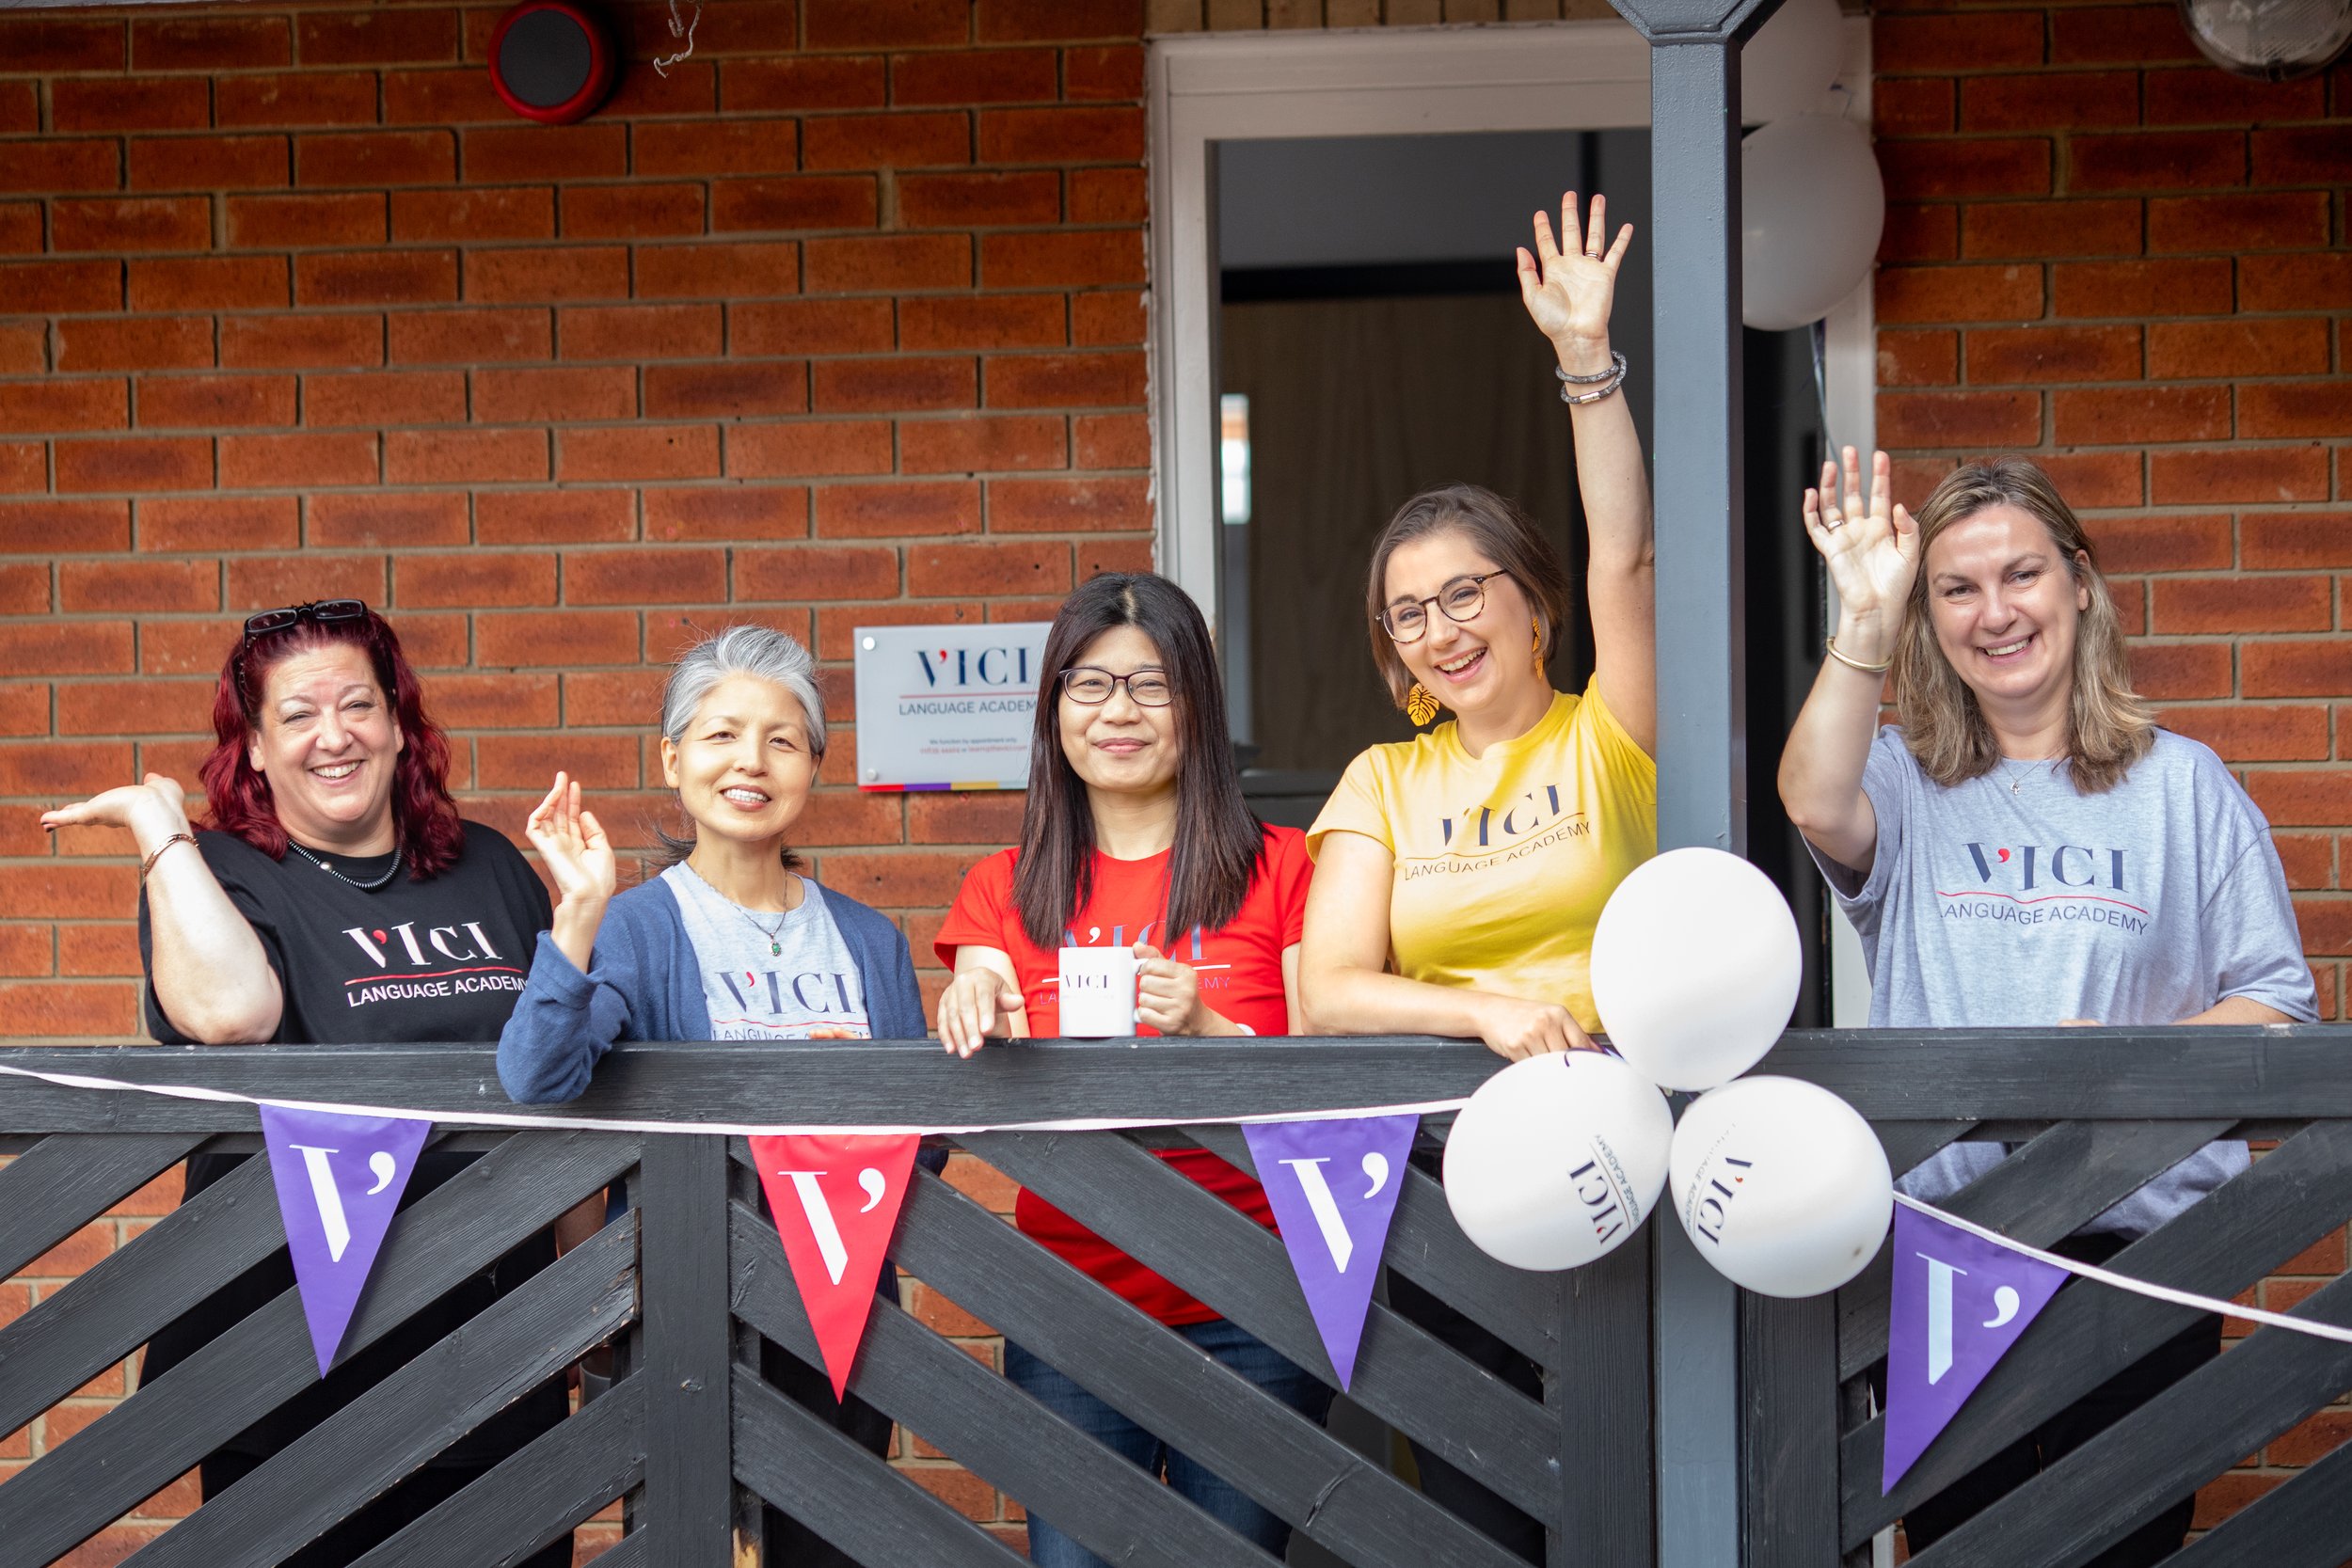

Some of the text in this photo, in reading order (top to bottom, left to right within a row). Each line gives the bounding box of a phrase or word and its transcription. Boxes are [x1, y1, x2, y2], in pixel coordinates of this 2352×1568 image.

[898, 699, 1037, 716] LANGUAGE ACADEM
[1405, 821, 1591, 881] LANGUAGE ACADEMY
[1940, 903, 2148, 936] ANGUAGE ACADEMY
[347, 981, 452, 1007] LANGUAGE
